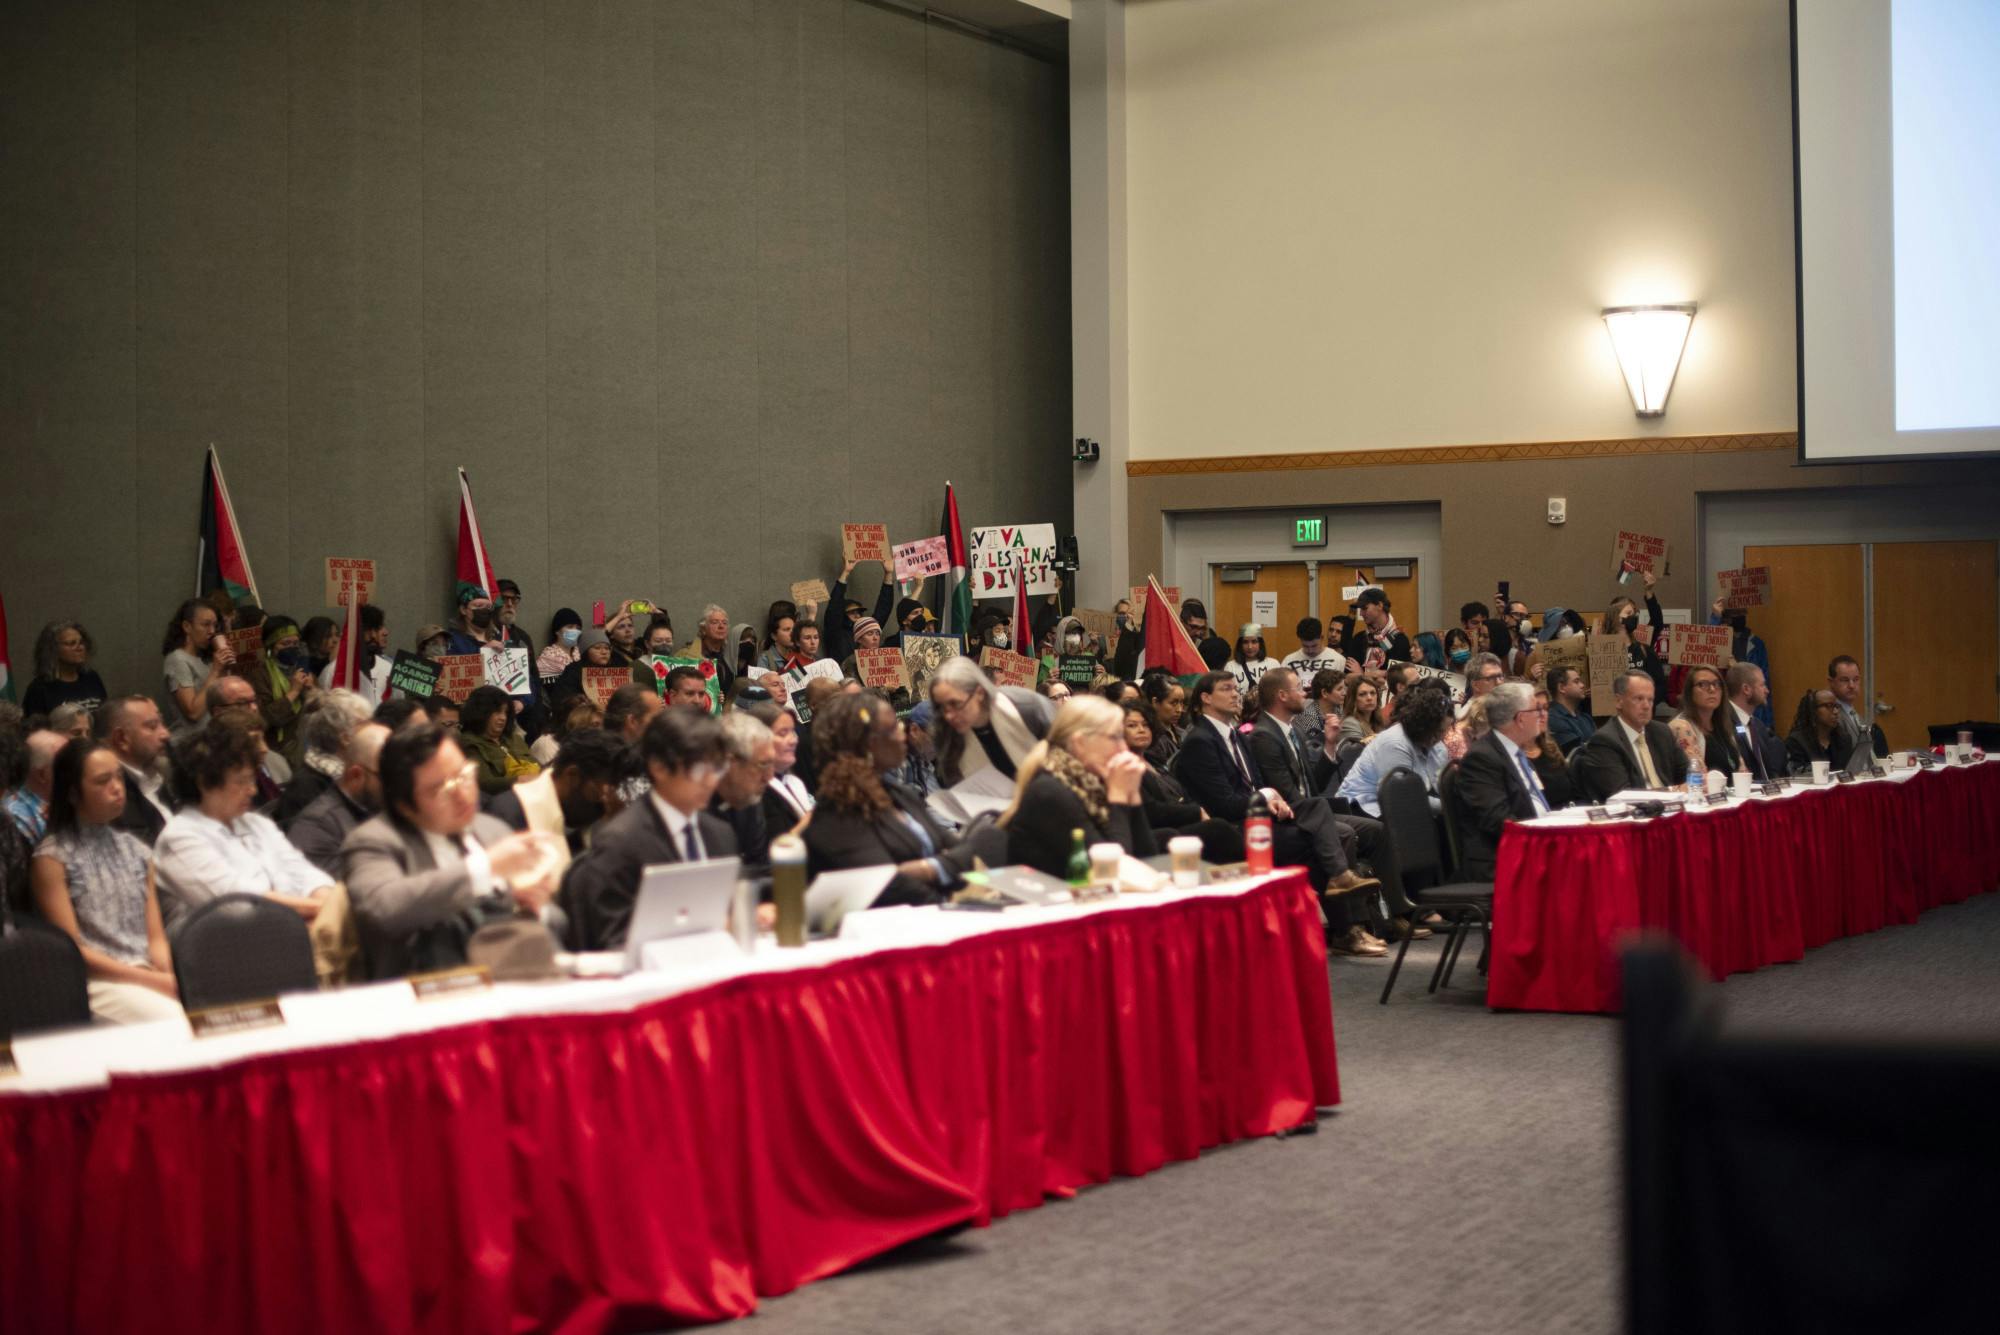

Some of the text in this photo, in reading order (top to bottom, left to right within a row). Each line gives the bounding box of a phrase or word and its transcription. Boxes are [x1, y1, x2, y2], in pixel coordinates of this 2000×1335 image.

[845, 524, 883, 532] DISCLOSURE
[1297, 519, 1321, 541] EXIT
[855, 532, 864, 541] NOT
[974, 527, 1025, 548] VIVA
[1619, 531, 1664, 546] DISCLOSURE
[856, 541, 879, 549] DURING
[854, 549, 882, 560] GENOCIDE
[900, 546, 915, 558] UNM
[1626, 551, 1652, 562] DURING
[330, 559, 373, 569] DISCLOSURE
[908, 552, 933, 566] DIVEST
[925, 561, 942, 573] NOW
[1718, 567, 1767, 579] DISCLOSURE
[1731, 585, 1759, 596] DURING
[1728, 594, 1763, 608] GENOCIDE
[1675, 624, 1728, 636] DISCLOSURE
[1688, 633, 1700, 643] NOT
[1706, 635, 1729, 647] ENOUGH
[858, 648, 900, 657] DISCLOSURE
[1685, 644, 1717, 654] DURING
[1681, 653, 1720, 666] GENOCIDE
[394, 663, 437, 684] AGAINST
[587, 667, 629, 676] DISCLOSURE
[869, 666, 896, 676] DURING
[1060, 664, 1094, 672] AGAINST
[1288, 658, 1335, 677] FREE
[391, 673, 433, 697] APARTHEID
[450, 678, 474, 689] DURING
